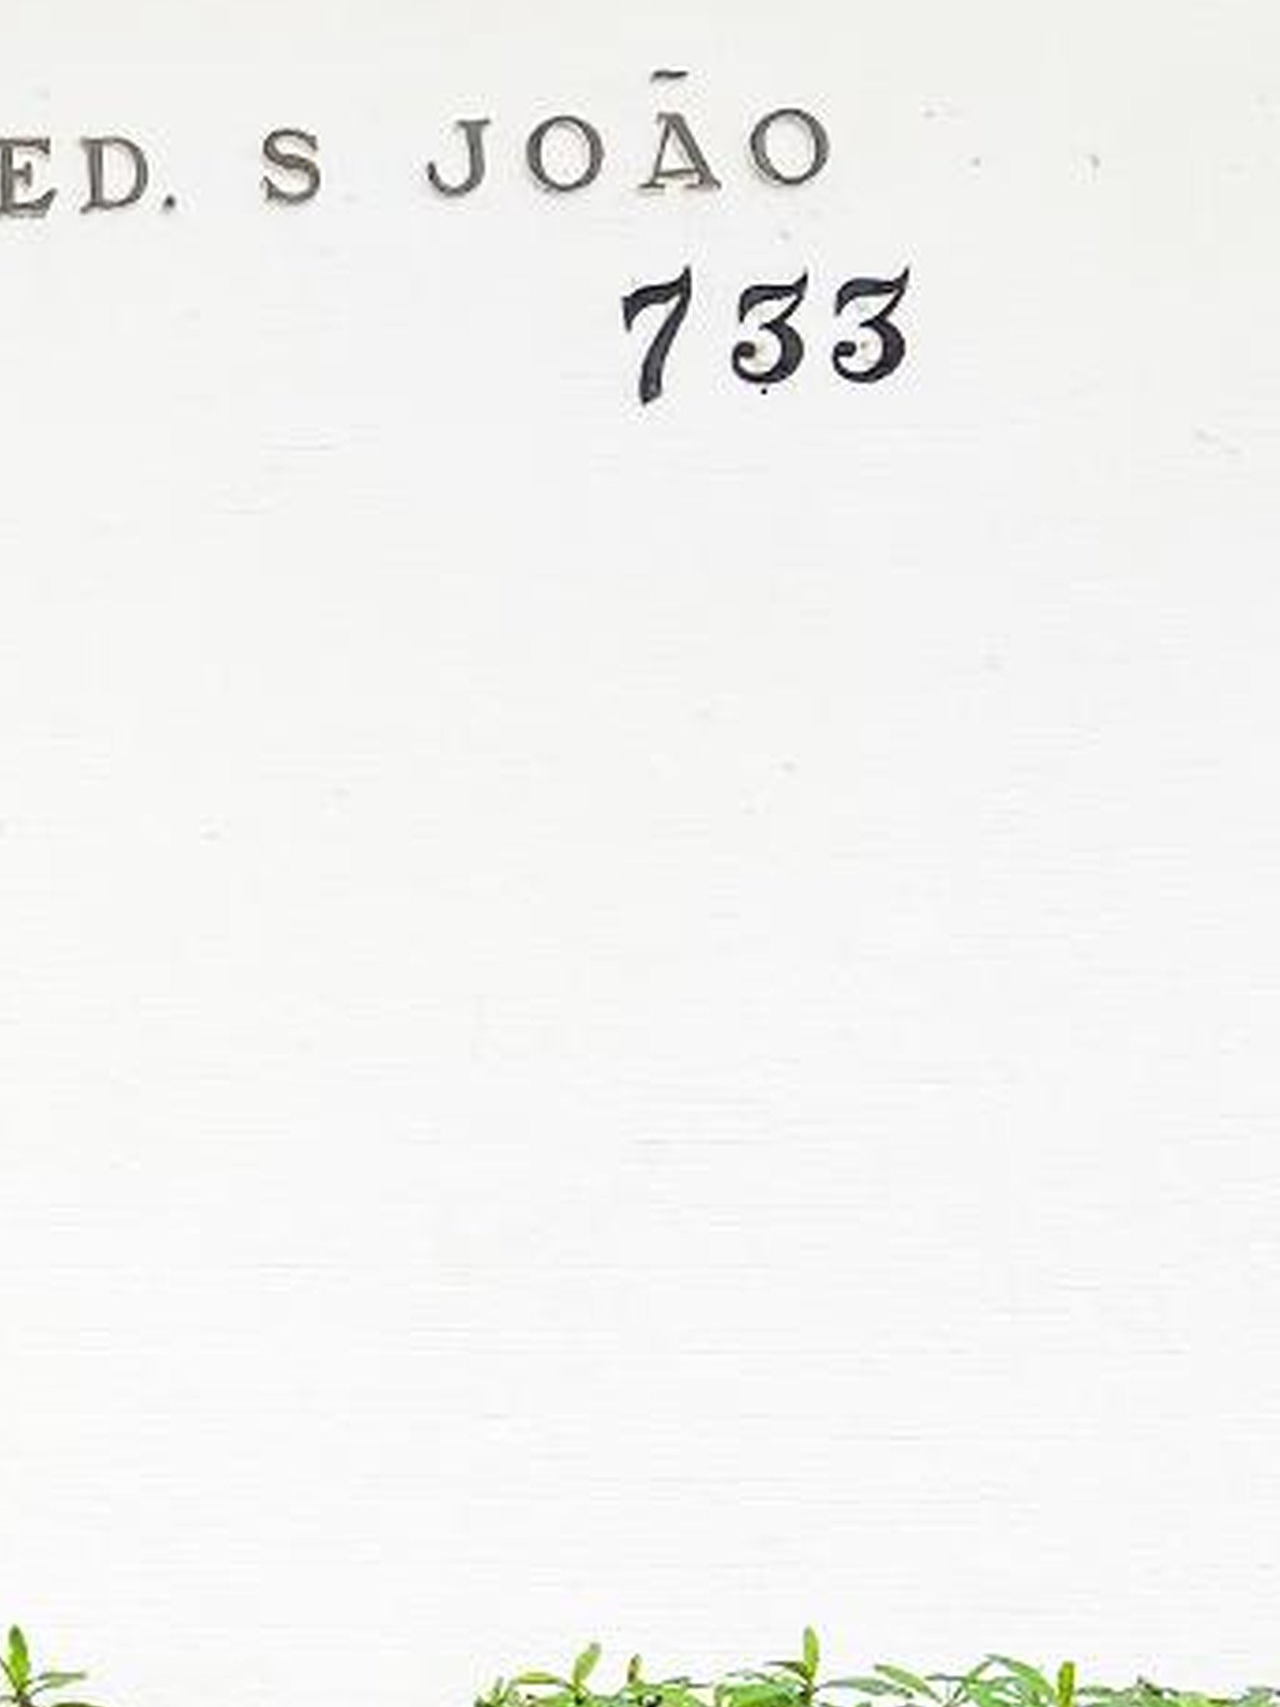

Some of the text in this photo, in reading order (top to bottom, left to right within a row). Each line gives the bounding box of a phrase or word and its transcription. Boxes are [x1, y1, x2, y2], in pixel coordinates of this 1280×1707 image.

[261, 128, 322, 205] S
[426, 69, 831, 199] JOÃO
[621, 266, 910, 404] 733
